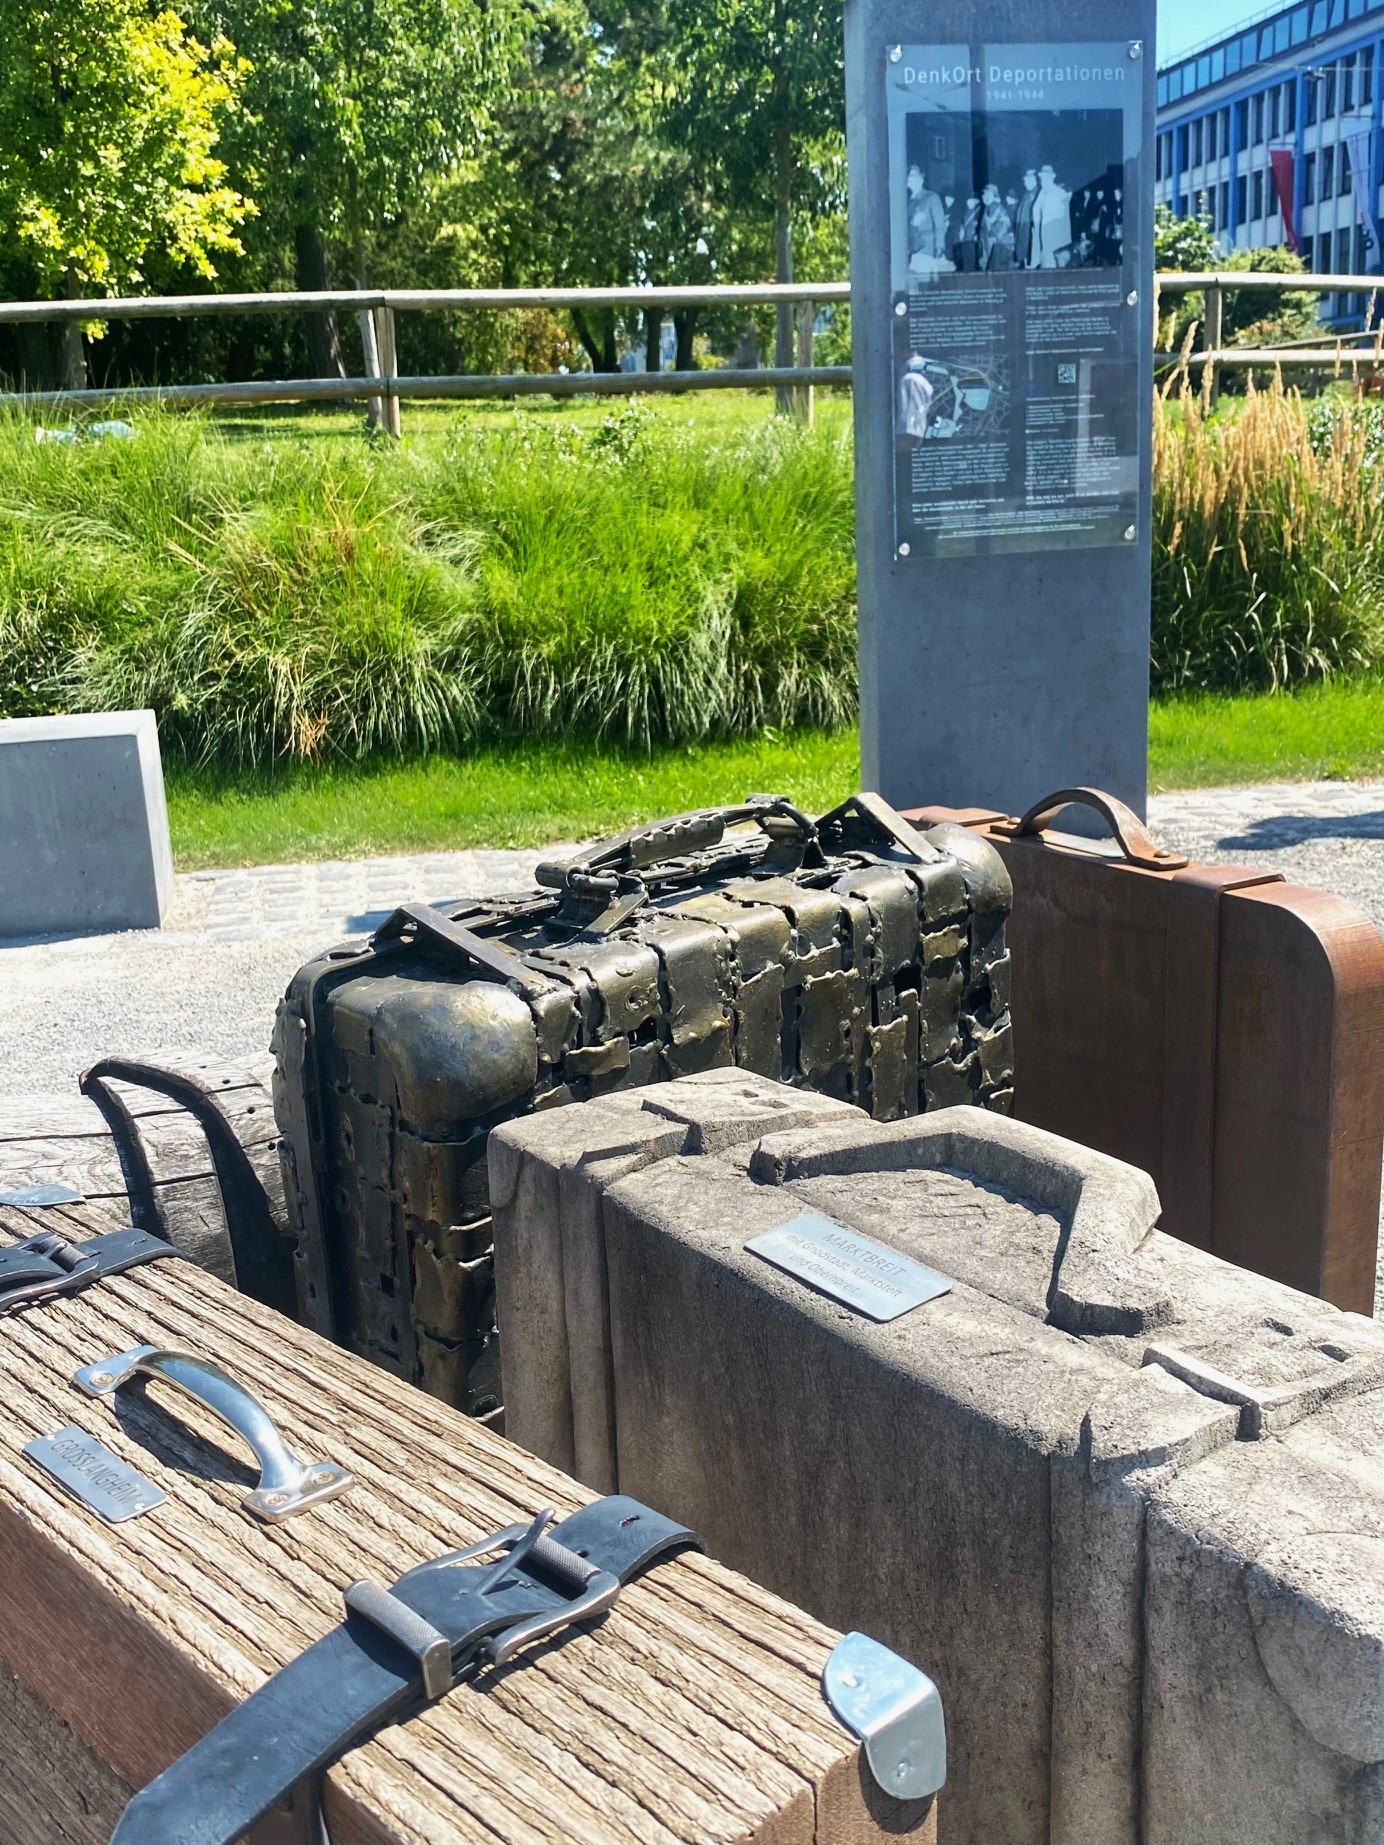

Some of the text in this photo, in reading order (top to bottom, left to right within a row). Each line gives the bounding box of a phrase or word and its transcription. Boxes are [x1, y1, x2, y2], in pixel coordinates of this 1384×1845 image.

[904, 65, 1125, 86] DenkOrt Deportationen
[987, 90, 1044, 100] 1941-1944
[786, 1234, 905, 1298] mit Gnodstadt, Marktsteft
[789, 1254, 861, 1295] und Obernbreit
[822, 1233, 907, 1278] MARKTBREIT
[50, 1439, 144, 1505] GROSSLANGHEIM
